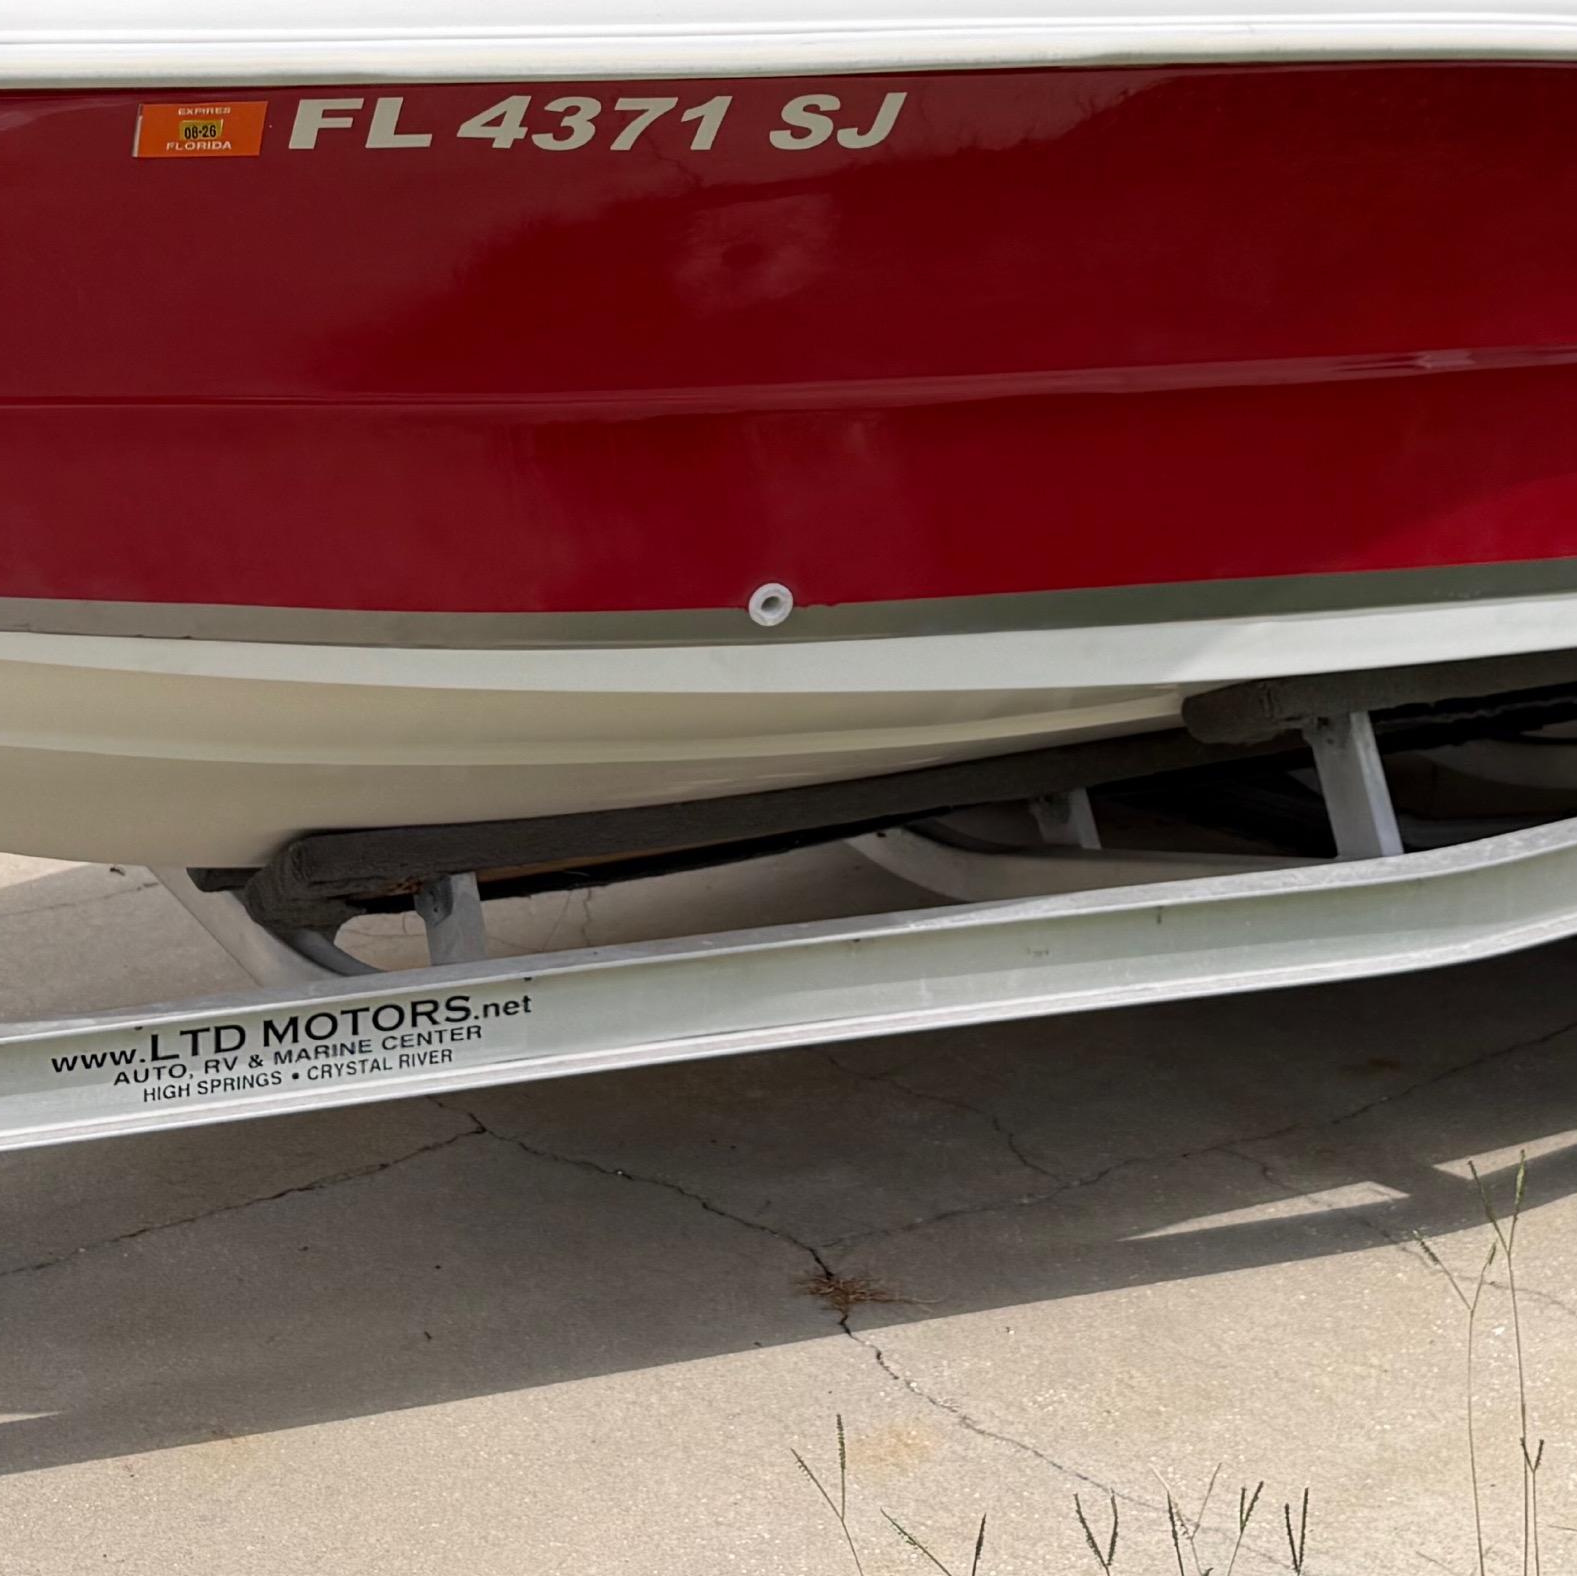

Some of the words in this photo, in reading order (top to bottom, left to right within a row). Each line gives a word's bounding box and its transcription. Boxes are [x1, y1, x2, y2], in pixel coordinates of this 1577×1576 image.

[177, 106, 232, 116] EXPIRES
[288, 96, 433, 150] FL
[456, 95, 733, 151] 4371
[769, 92, 908, 151] SJ
[165, 140, 233, 151] FLORIDA
[113, 1063, 194, 1086] AUTO,
[204, 1055, 239, 1075] RV
[248, 1054, 264, 1069] &
[273, 1038, 373, 1066] MARINE
[382, 1025, 483, 1051] CENTER
[143, 1082, 191, 1103] HIGH
[197, 1070, 283, 1096] SPRINGS
[307, 1056, 393, 1081] CRYSTAL
[399, 1048, 453, 1070] RIVER
